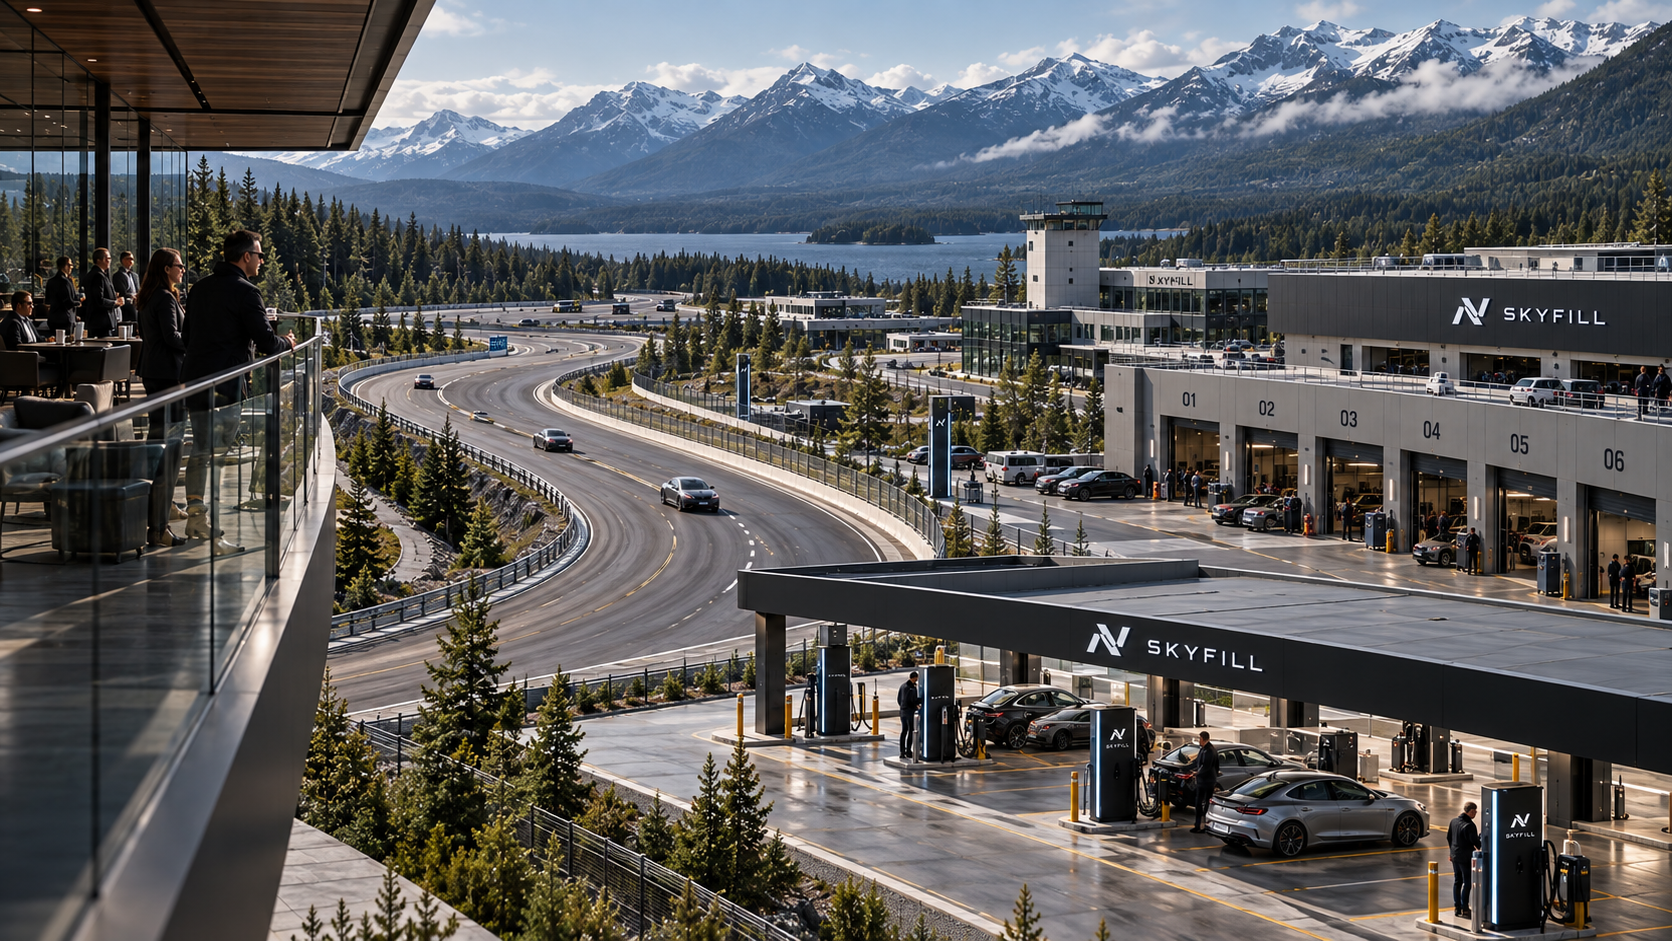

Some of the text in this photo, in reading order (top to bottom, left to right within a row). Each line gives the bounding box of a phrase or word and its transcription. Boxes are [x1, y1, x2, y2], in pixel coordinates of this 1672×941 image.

[1503, 307, 1606, 325] SKYFILL
[1182, 391, 1196, 408] 01
[1258, 400, 1275, 417] 02
[1340, 409, 1358, 428] 03
[1423, 420, 1441, 440] 04
[1510, 433, 1529, 455] 05
[1604, 448, 1624, 472] 06
[1147, 639, 1263, 672] SKYFILL
